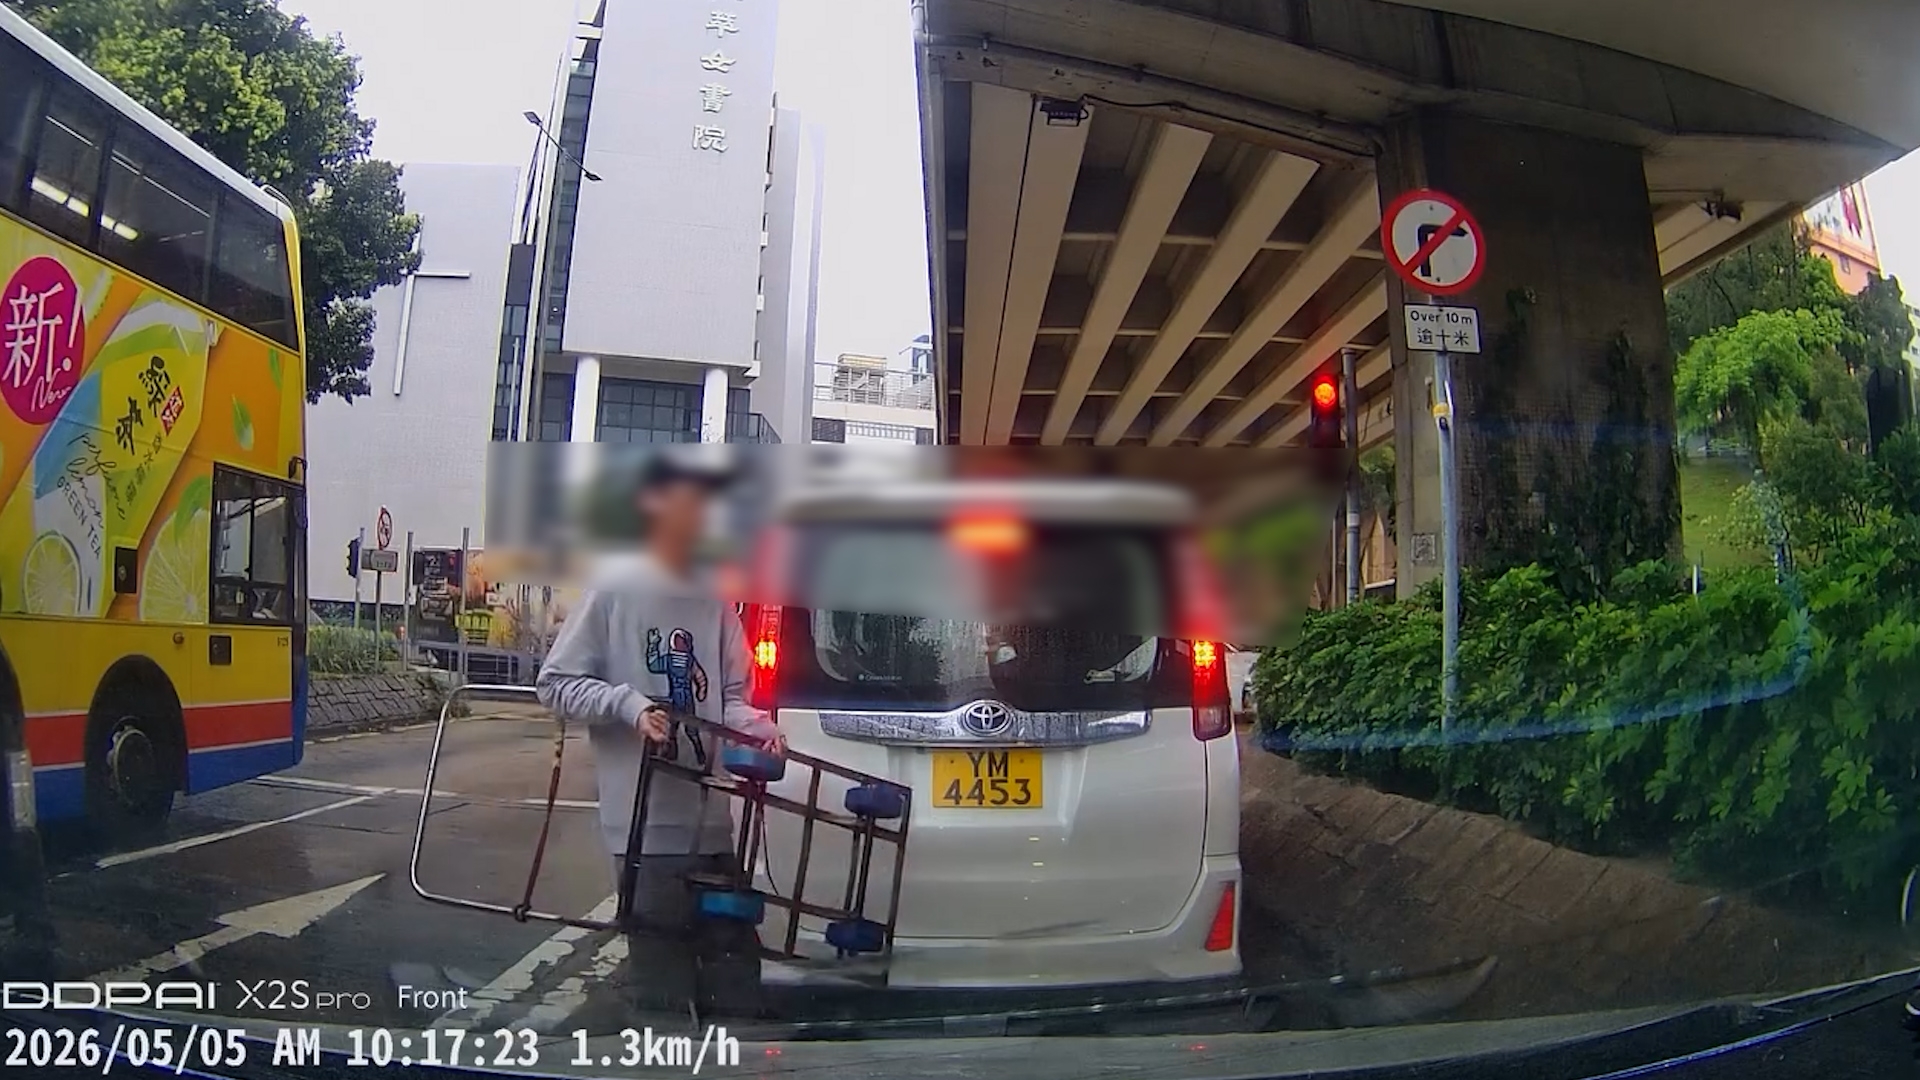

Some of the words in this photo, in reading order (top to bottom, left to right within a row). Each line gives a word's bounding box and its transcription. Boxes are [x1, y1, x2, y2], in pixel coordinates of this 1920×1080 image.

[1410, 310, 1440, 323] Over
[1417, 327, 1469, 346] 逾十米
[56, 476, 89, 526] GREEN
[87, 523, 102, 560] TEA
[966, 751, 1009, 778] YM
[943, 778, 1032, 805] 4453
